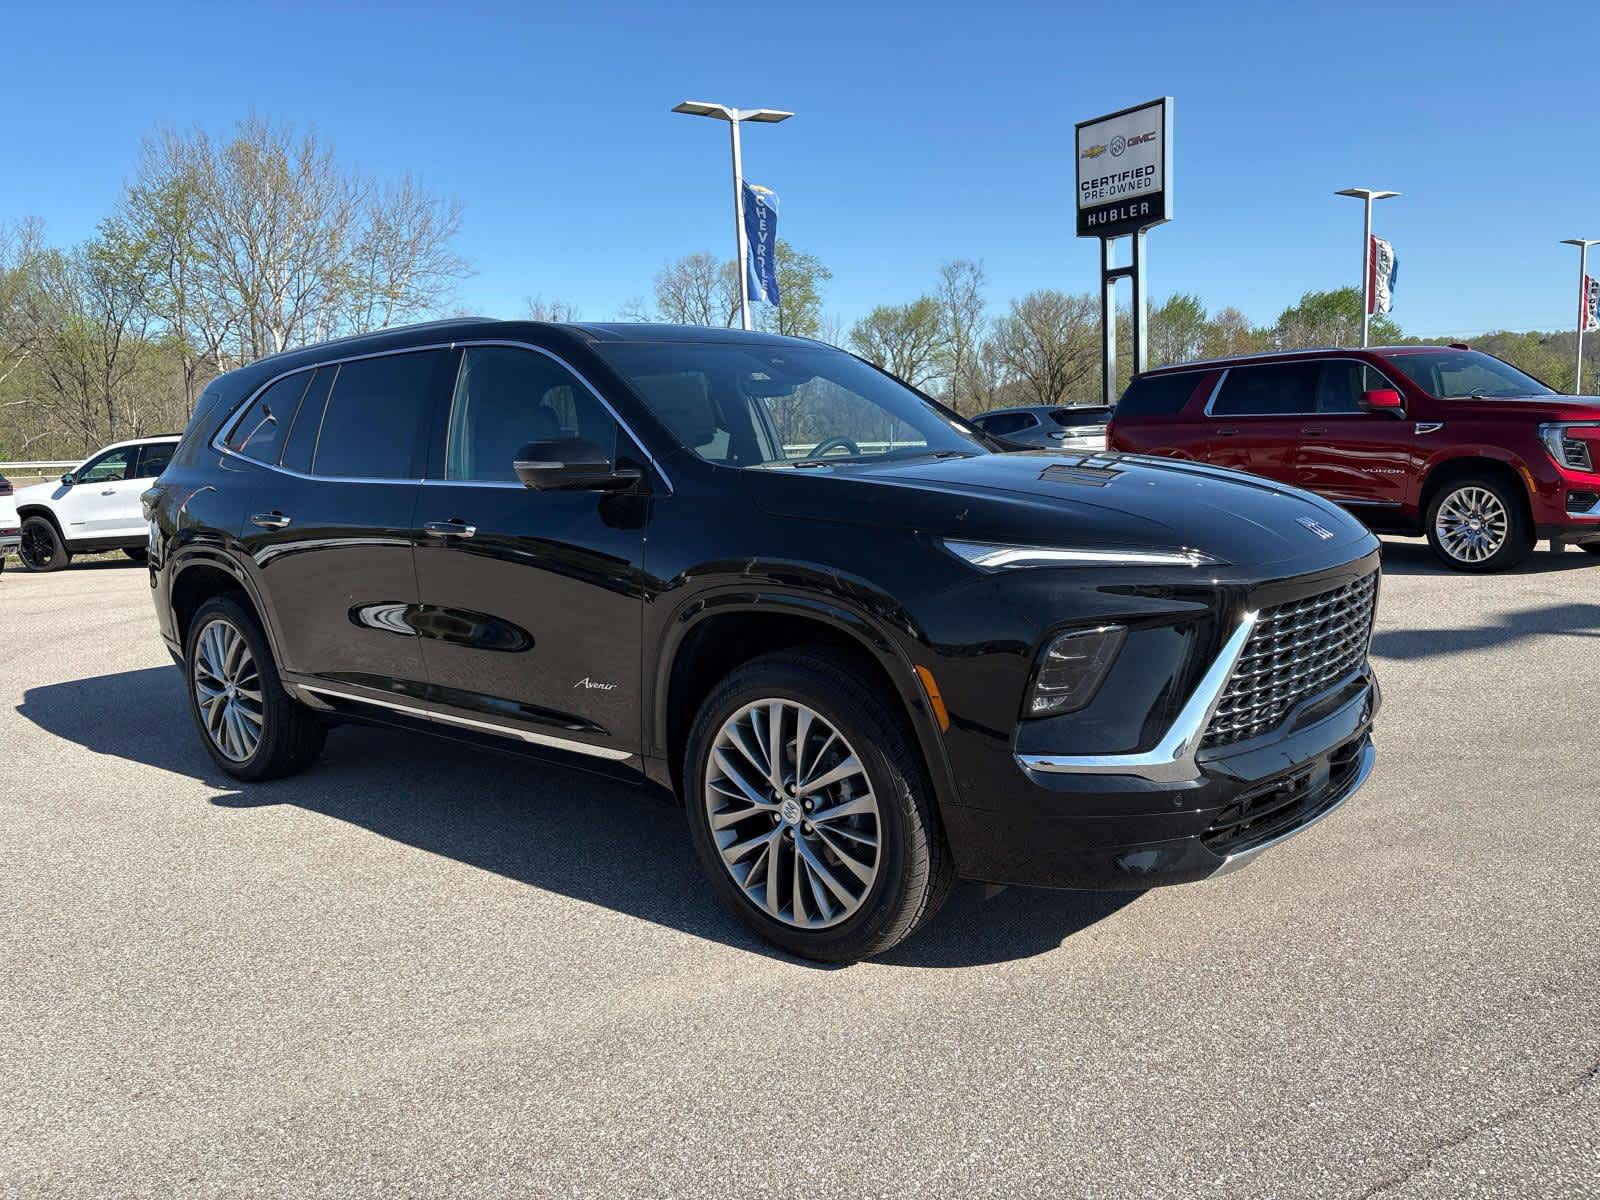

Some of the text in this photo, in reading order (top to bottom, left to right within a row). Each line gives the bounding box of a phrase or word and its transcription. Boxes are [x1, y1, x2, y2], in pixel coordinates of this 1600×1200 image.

[1127, 131, 1156, 147] GMC
[1081, 164, 1155, 191] CERTIFIED
[1084, 177, 1151, 201] PRE-OWNED
[1087, 202, 1150, 226] HUBLER
